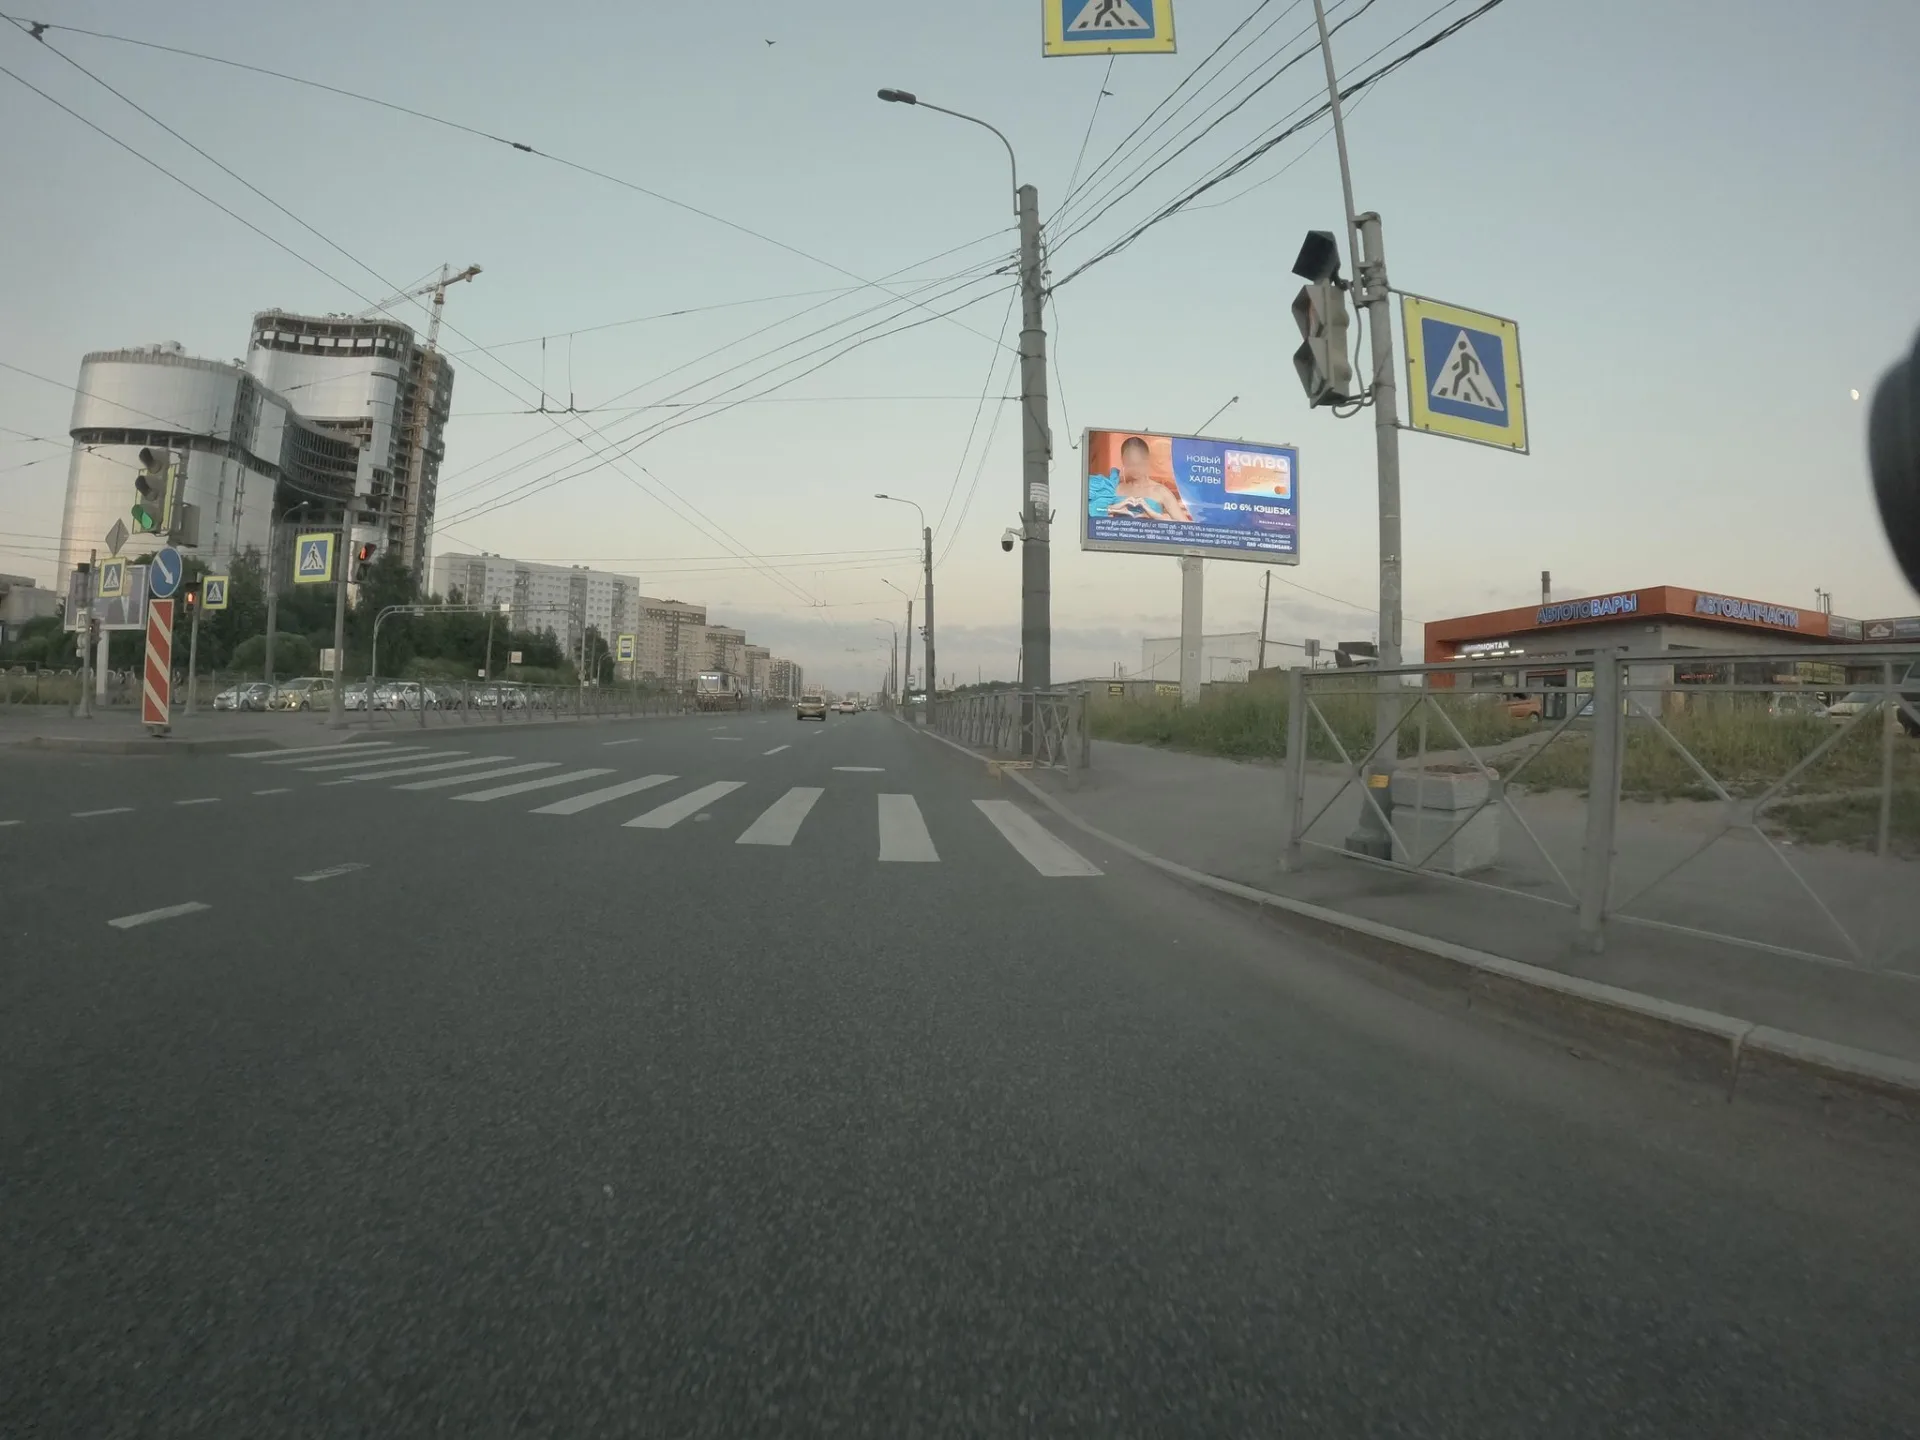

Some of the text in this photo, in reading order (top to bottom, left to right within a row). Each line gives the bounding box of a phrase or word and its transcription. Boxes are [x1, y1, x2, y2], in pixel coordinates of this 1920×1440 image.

[1186, 454, 1221, 464] НОВЫЙ
[1191, 465, 1221, 475] СТИЛЬ
[1189, 475, 1221, 485] ХАЛВЫ
[1223, 502, 1291, 516] ДО 6% КЭШБЭК
[1536, 593, 1637, 624] АВТОТОВАРЫ
[1695, 594, 1800, 628] АВТОЗАПЧАСТИ
[1463, 641, 1510, 652] ОМОНТАЖ
